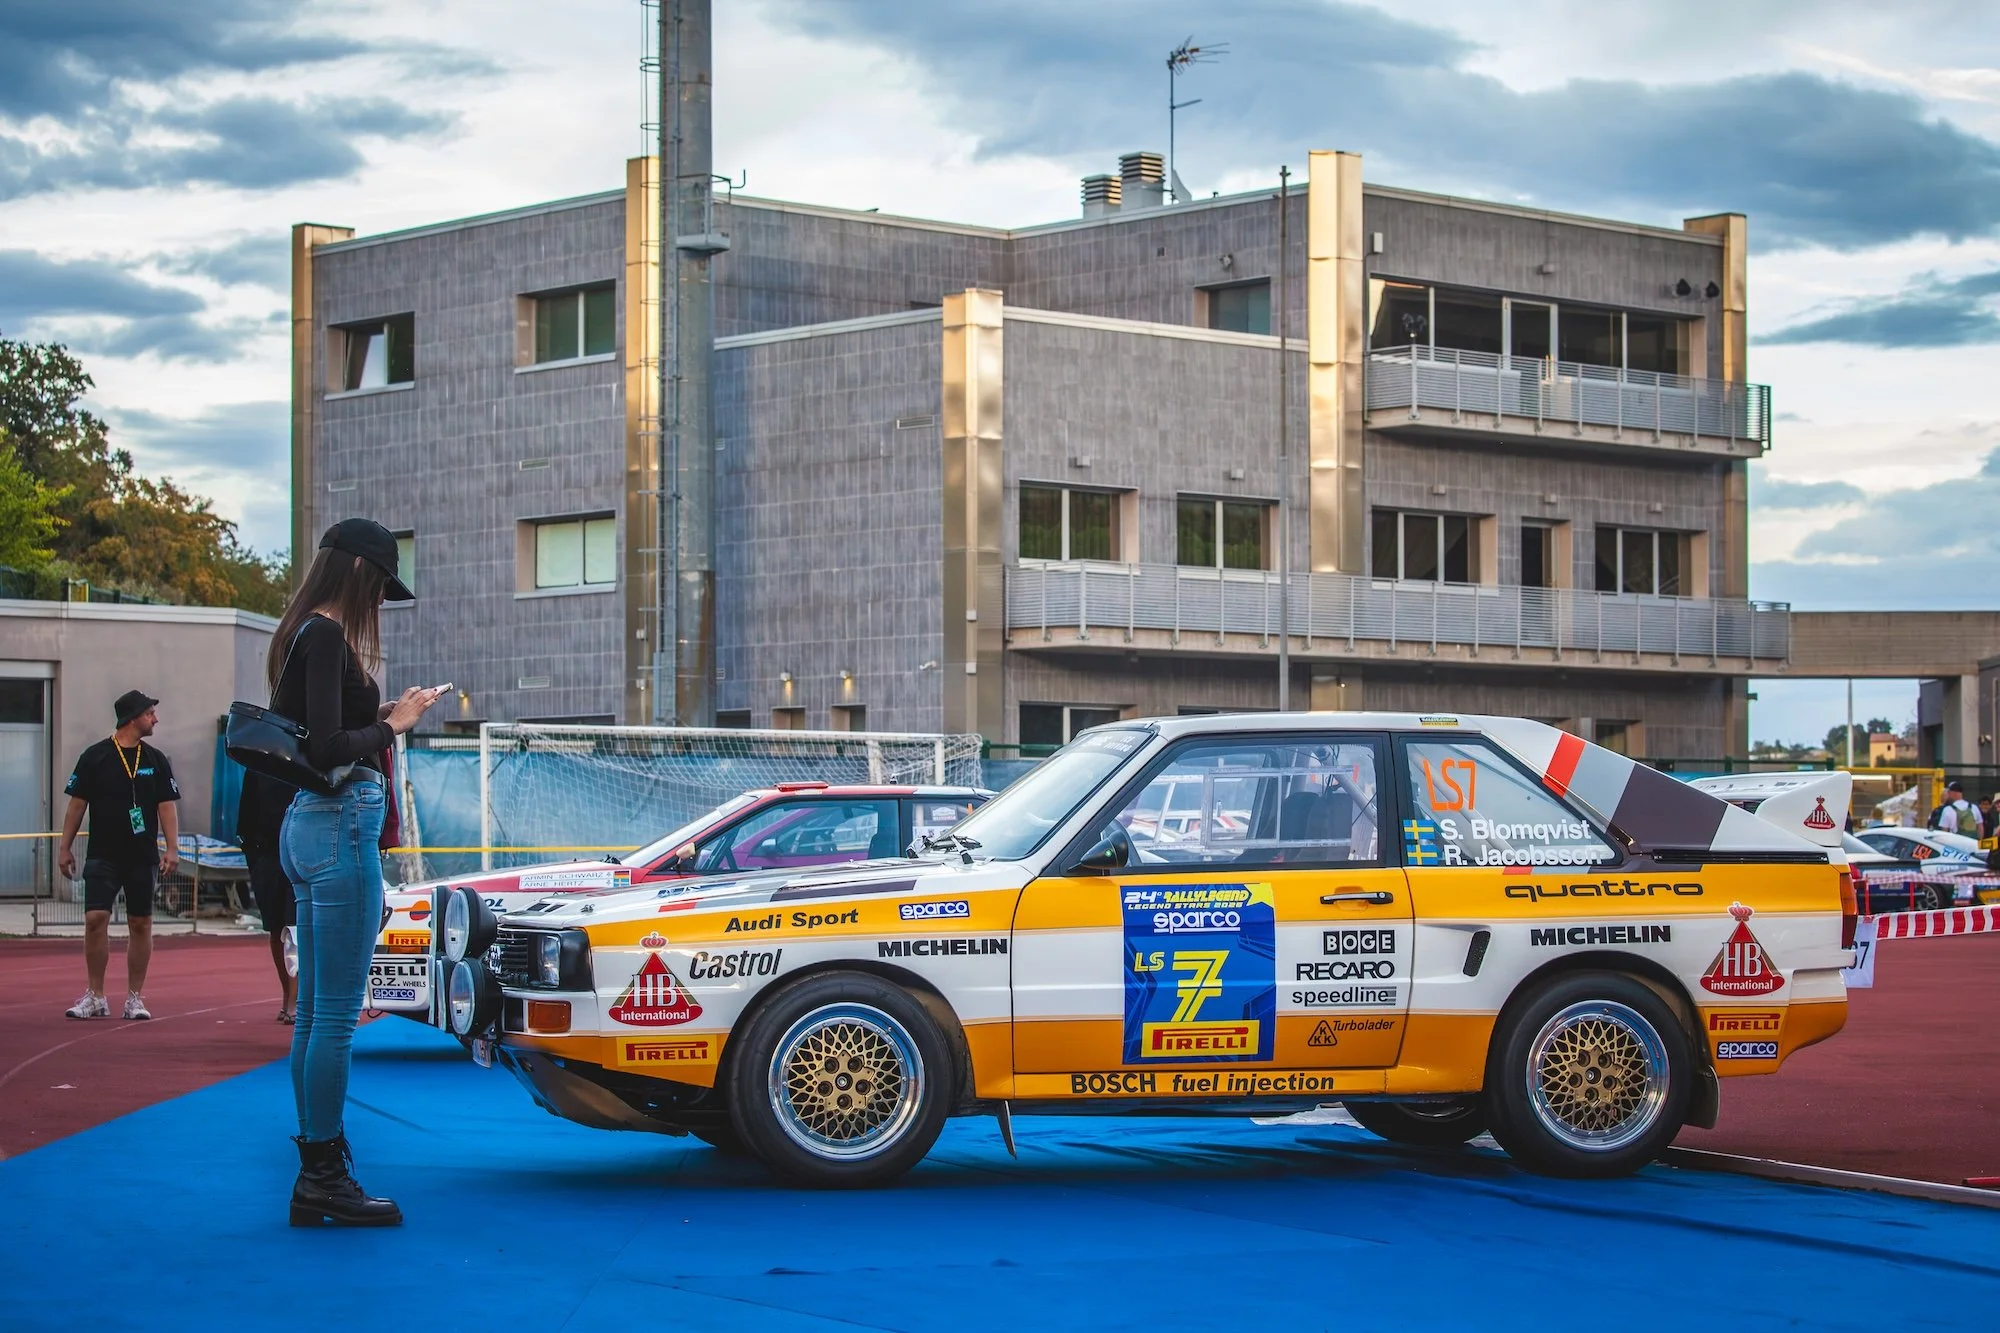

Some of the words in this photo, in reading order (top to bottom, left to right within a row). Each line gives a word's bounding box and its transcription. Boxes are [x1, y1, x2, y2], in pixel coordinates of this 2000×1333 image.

[1423, 758, 1476, 812] LS7
[1440, 819, 1464, 840] S.
[1471, 819, 1592, 844] Blomqvist
[1443, 845, 1467, 865] R.
[1475, 844, 1603, 866] Jacobsson
[553, 879, 584, 887] HERTZ
[559, 871, 604, 879] SCHWARZ
[1504, 880, 1704, 902] quattro
[901, 901, 969, 919] sparco
[1127, 902, 1172, 910] LEGEND
[725, 914, 782, 933] Audi
[791, 908, 859, 929] Sport
[1153, 911, 1241, 934] sparco
[388, 933, 431, 945] PIREL
[1324, 931, 1394, 953] BOGE
[1530, 925, 1672, 947] MICHELIN
[877, 938, 1008, 958] MICHELIN
[689, 949, 783, 980] Castrol
[1721, 941, 1763, 978] HB
[1296, 960, 1396, 981] RECARO
[370, 977, 401, 987] O.Z.
[402, 980, 427, 988] WHEELS
[631, 973, 678, 1008] HB
[1134, 951, 1166, 973] LS
[1171, 949, 1231, 1023] 7
[1710, 979, 1774, 991] international
[373, 989, 415, 1000] sparco
[1291, 985, 1392, 1007] speedline
[620, 1008, 690, 1021] international
[1332, 1018, 1396, 1032] Turbolader
[1709, 1013, 1781, 1031] PIRELLI
[1152, 1026, 1249, 1051] PIRELLI
[625, 1041, 709, 1061] PIRELLI
[1717, 1042, 1777, 1059] sparco
[1071, 1073, 1156, 1093] BOSCH
[1172, 1073, 1220, 1092] fuel
[1226, 1072, 1335, 1094] injection
